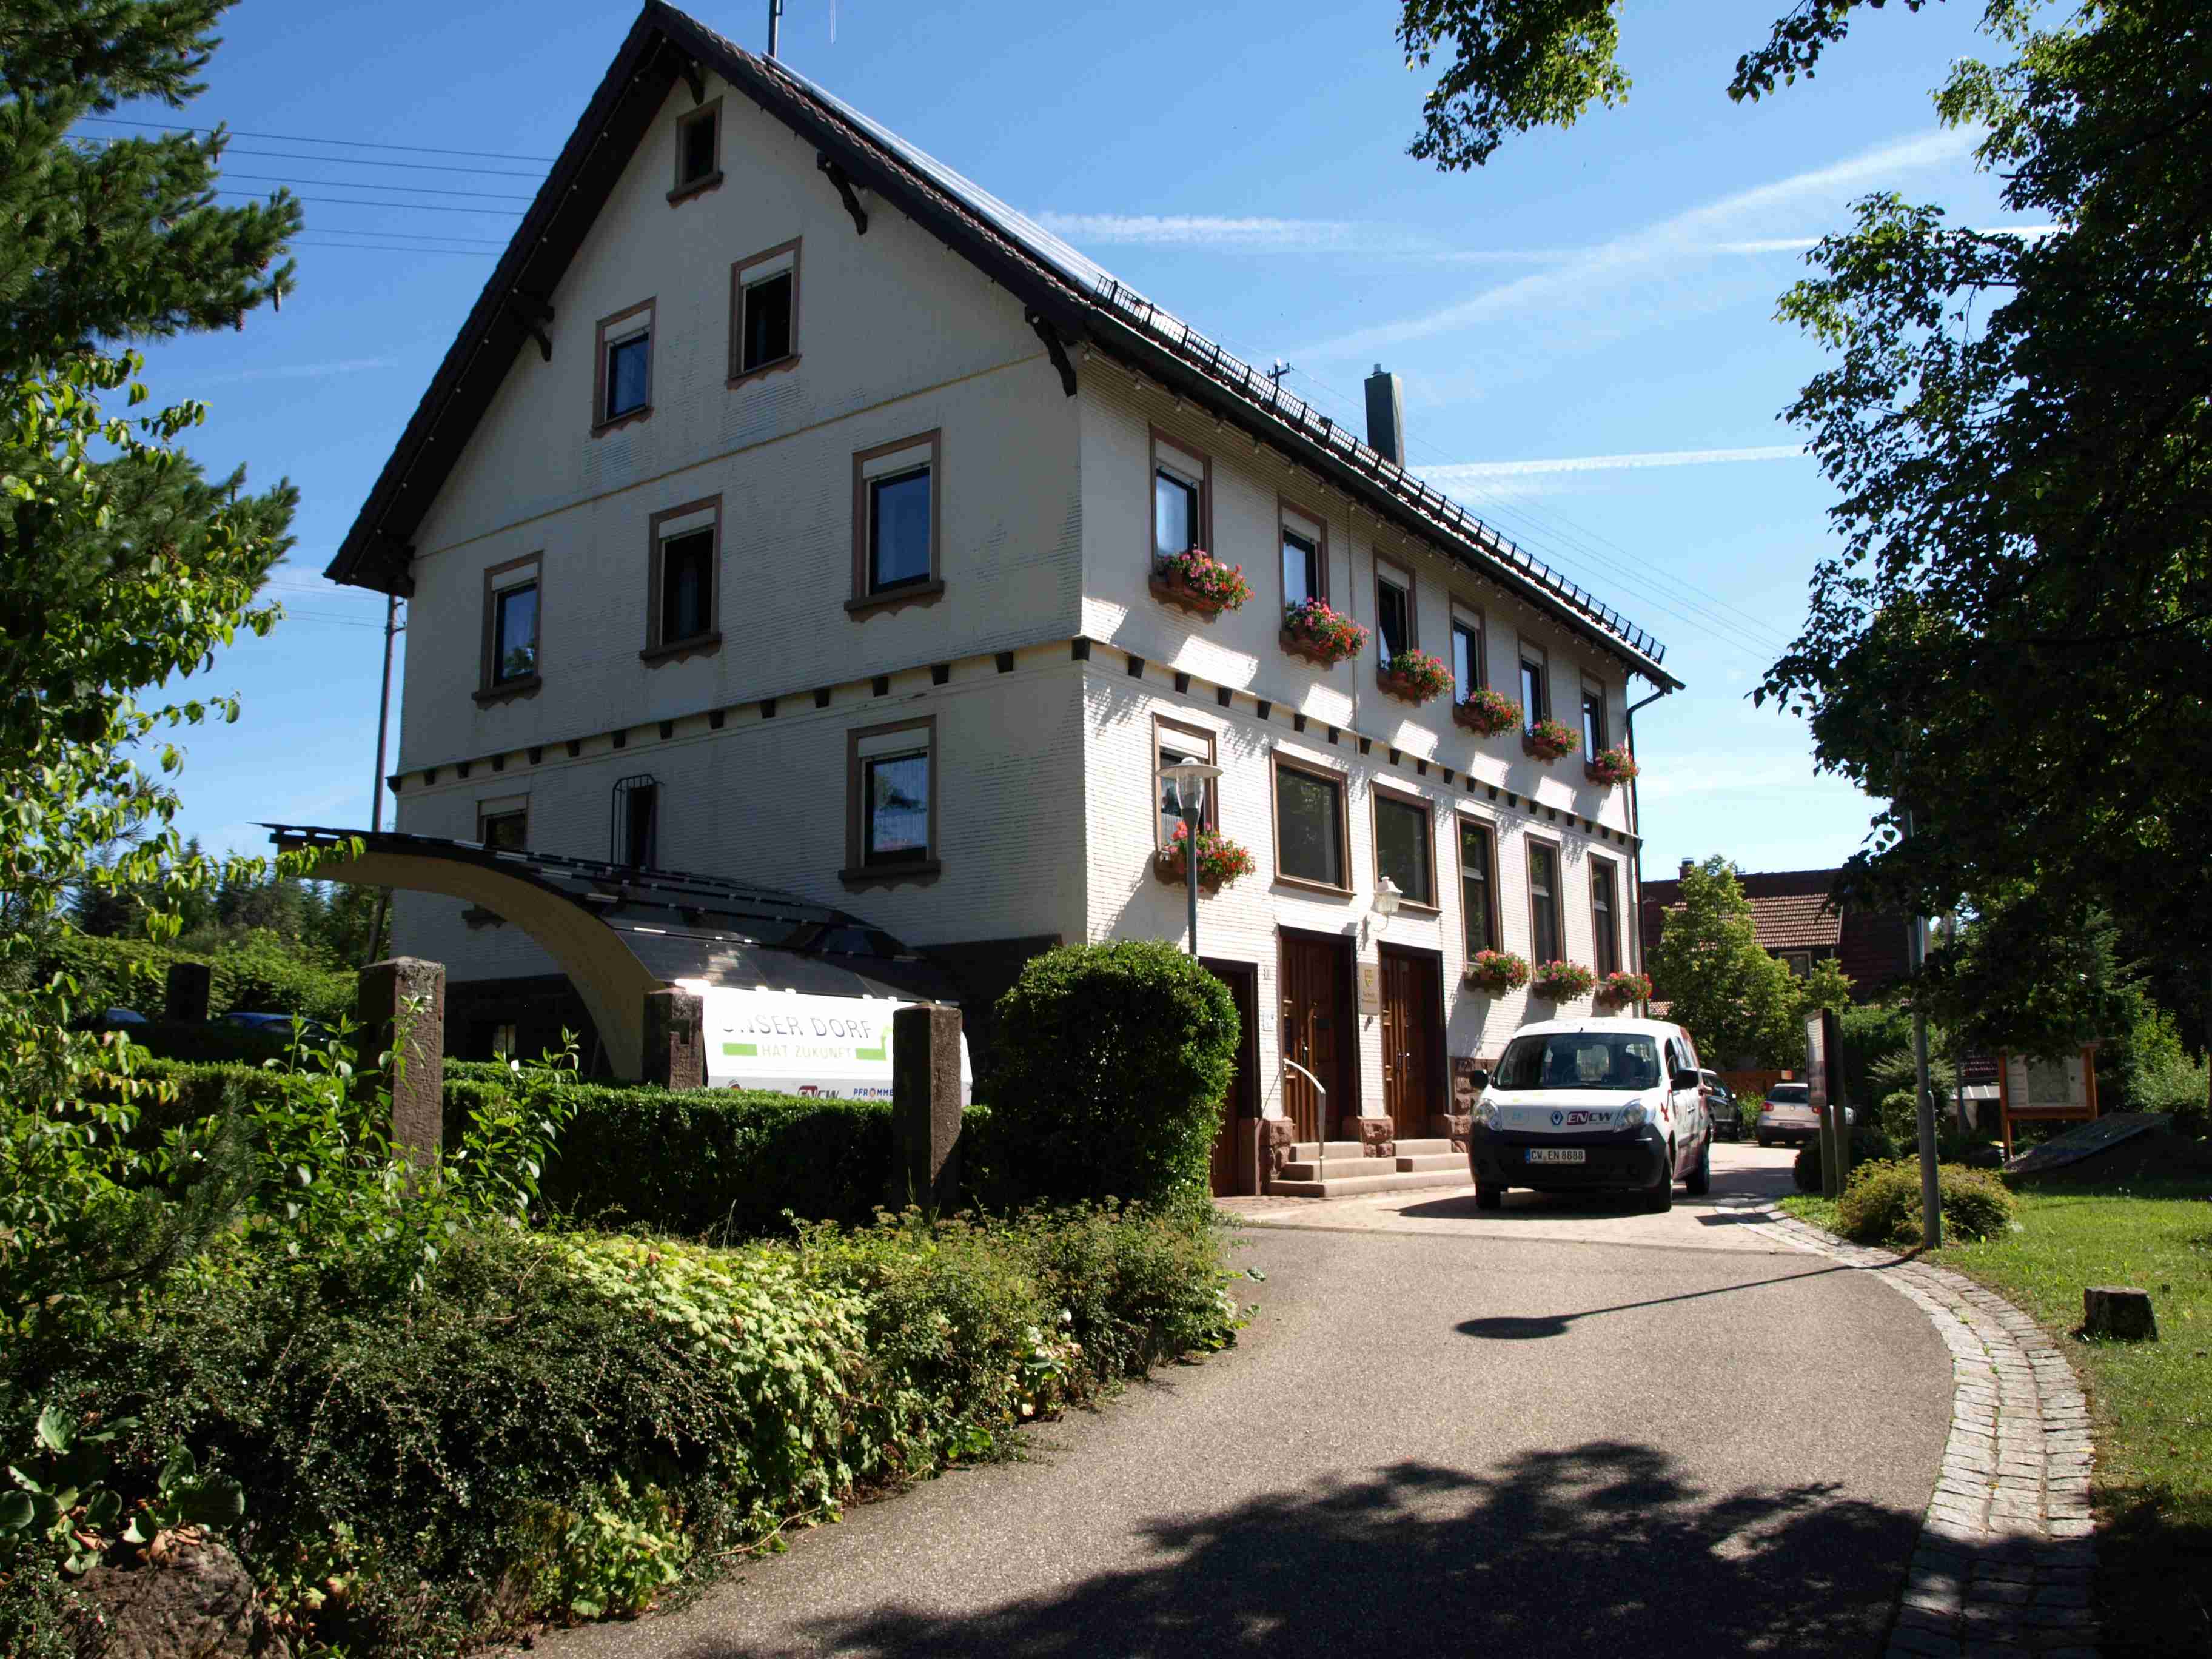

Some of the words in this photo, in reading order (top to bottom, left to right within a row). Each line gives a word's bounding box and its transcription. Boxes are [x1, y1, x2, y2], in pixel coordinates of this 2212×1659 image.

[811, 1017, 873, 1038] DORF
[762, 1044, 787, 1057] HAT
[796, 1045, 851, 1059] ZUKUNFT
[1532, 1151, 1543, 1160] CW
[1547, 1151, 1560, 1160] EN
[1561, 1151, 1584, 1160] 8888
